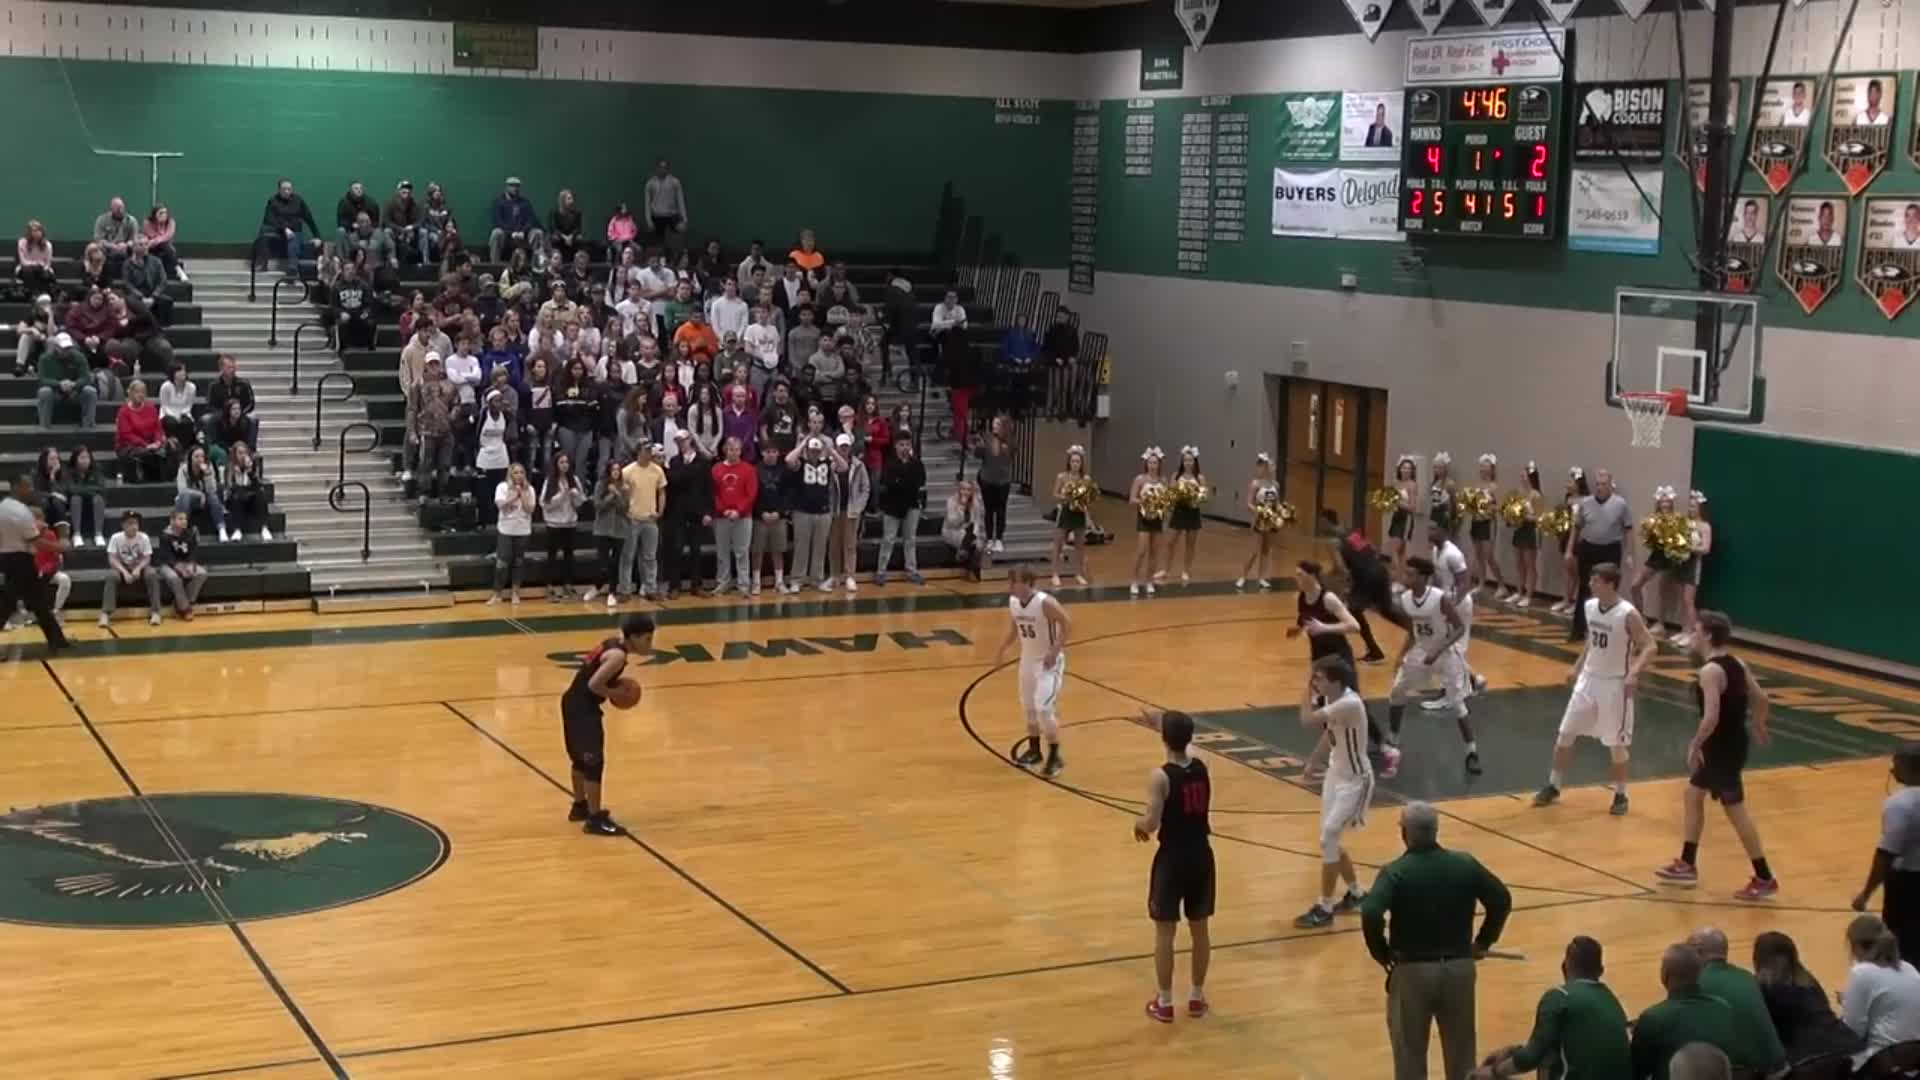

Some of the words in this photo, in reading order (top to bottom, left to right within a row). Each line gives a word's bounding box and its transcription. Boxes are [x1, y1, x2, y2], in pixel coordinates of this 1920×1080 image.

[1463, 86, 1508, 119] 4:46
[1613, 87, 1665, 111] BISON
[1612, 111, 1663, 125] COOLERS
[1409, 126, 1443, 142] HAWKS
[1514, 125, 1547, 141] GUEST
[1427, 146, 1442, 173] 4
[1531, 144, 1547, 178] 2
[1275, 186, 1336, 202] BUYERS
[1341, 173, 1400, 209] Delgad
[1411, 190, 1423, 215] 2
[1433, 190, 1444, 216] 5
[1503, 192, 1515, 218] 5
